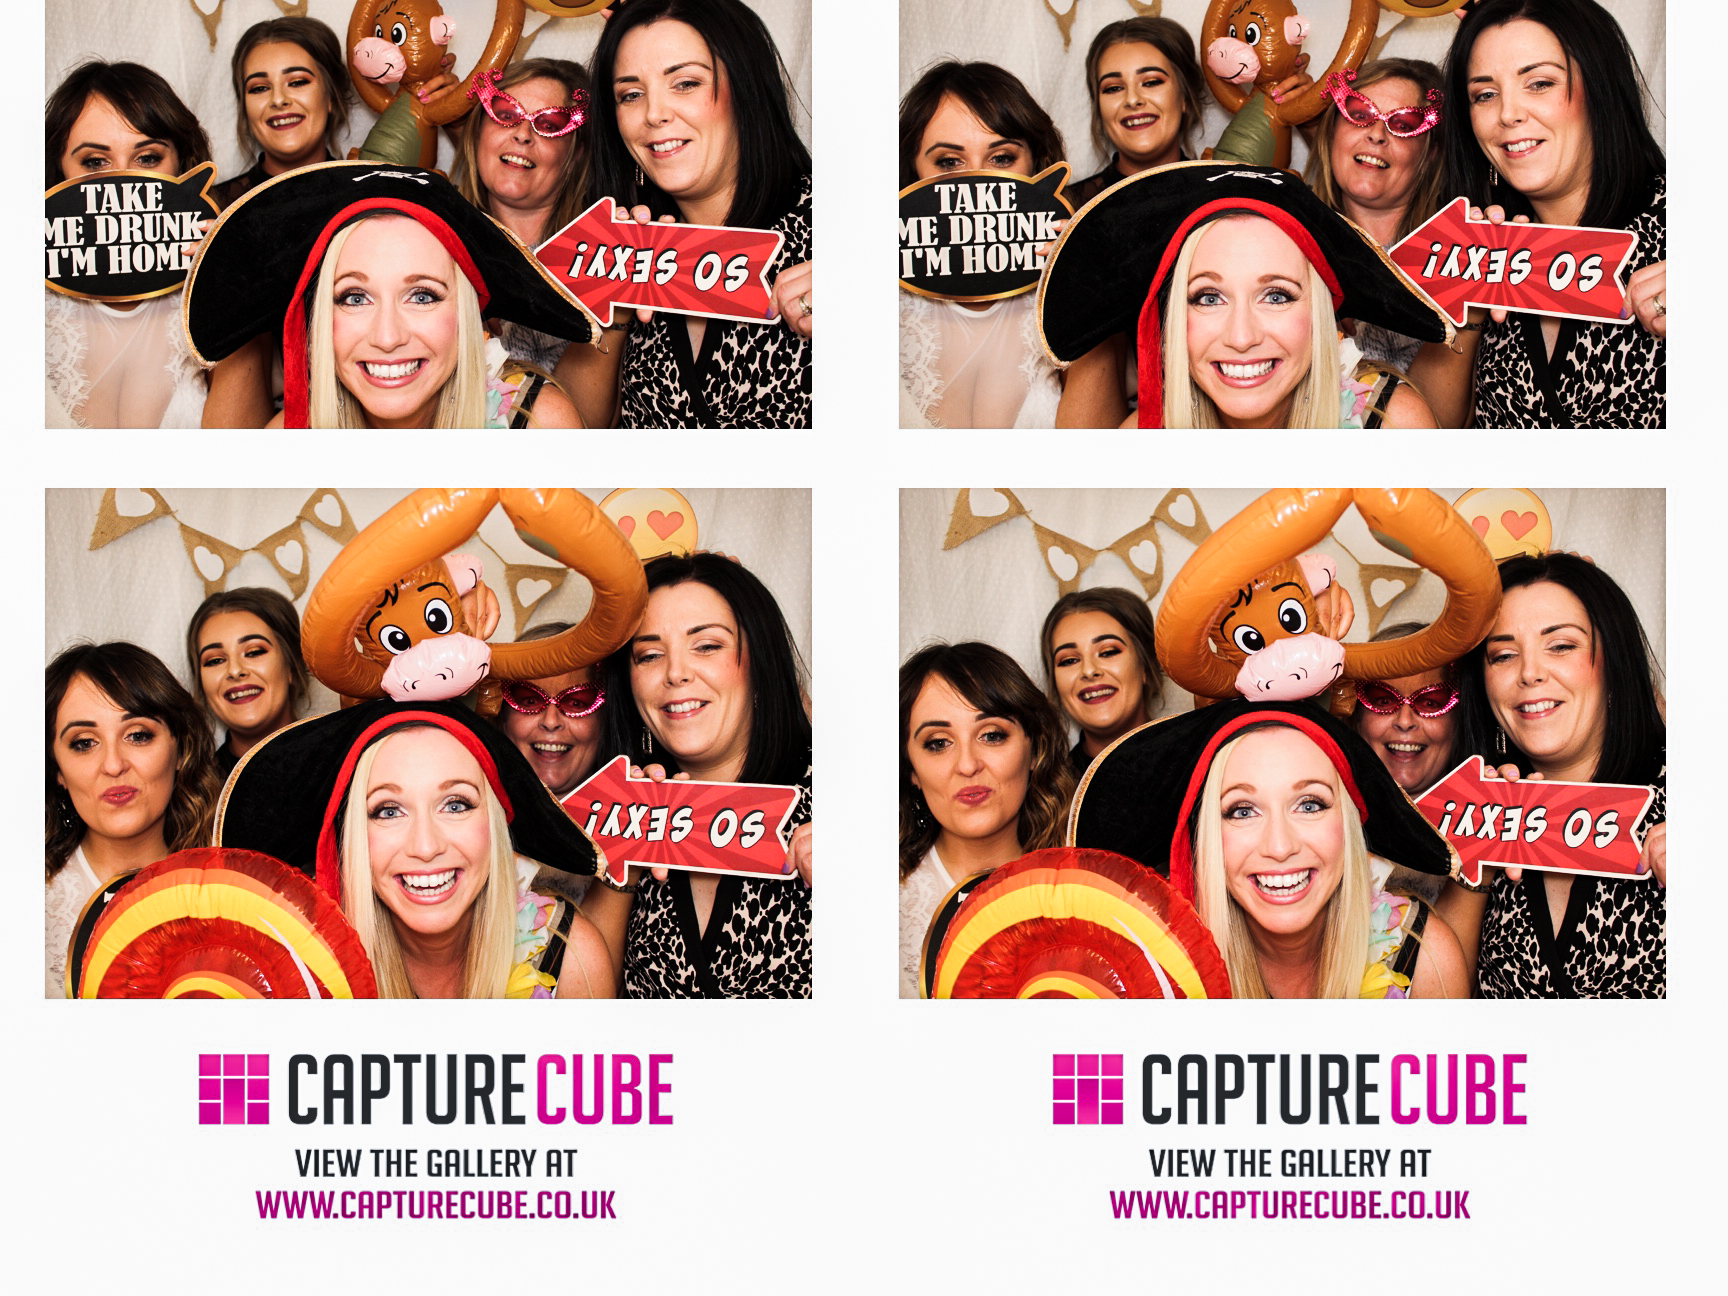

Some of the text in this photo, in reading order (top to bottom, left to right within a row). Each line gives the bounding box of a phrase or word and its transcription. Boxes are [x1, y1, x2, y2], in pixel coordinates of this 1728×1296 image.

[80, 182, 164, 214] TAKE
[934, 182, 1018, 214] TAKE
[45, 211, 204, 248] ME DRUNK
[899, 211, 1058, 248] ME DRUNK
[46, 246, 98, 278] I'M
[567, 241, 750, 293] SO SEXY!
[900, 246, 952, 278] I'M
[1421, 241, 1604, 293] SO SEXY!
[584, 799, 766, 849] SO SEXY!
[1438, 799, 1620, 849] SO SEXY!
